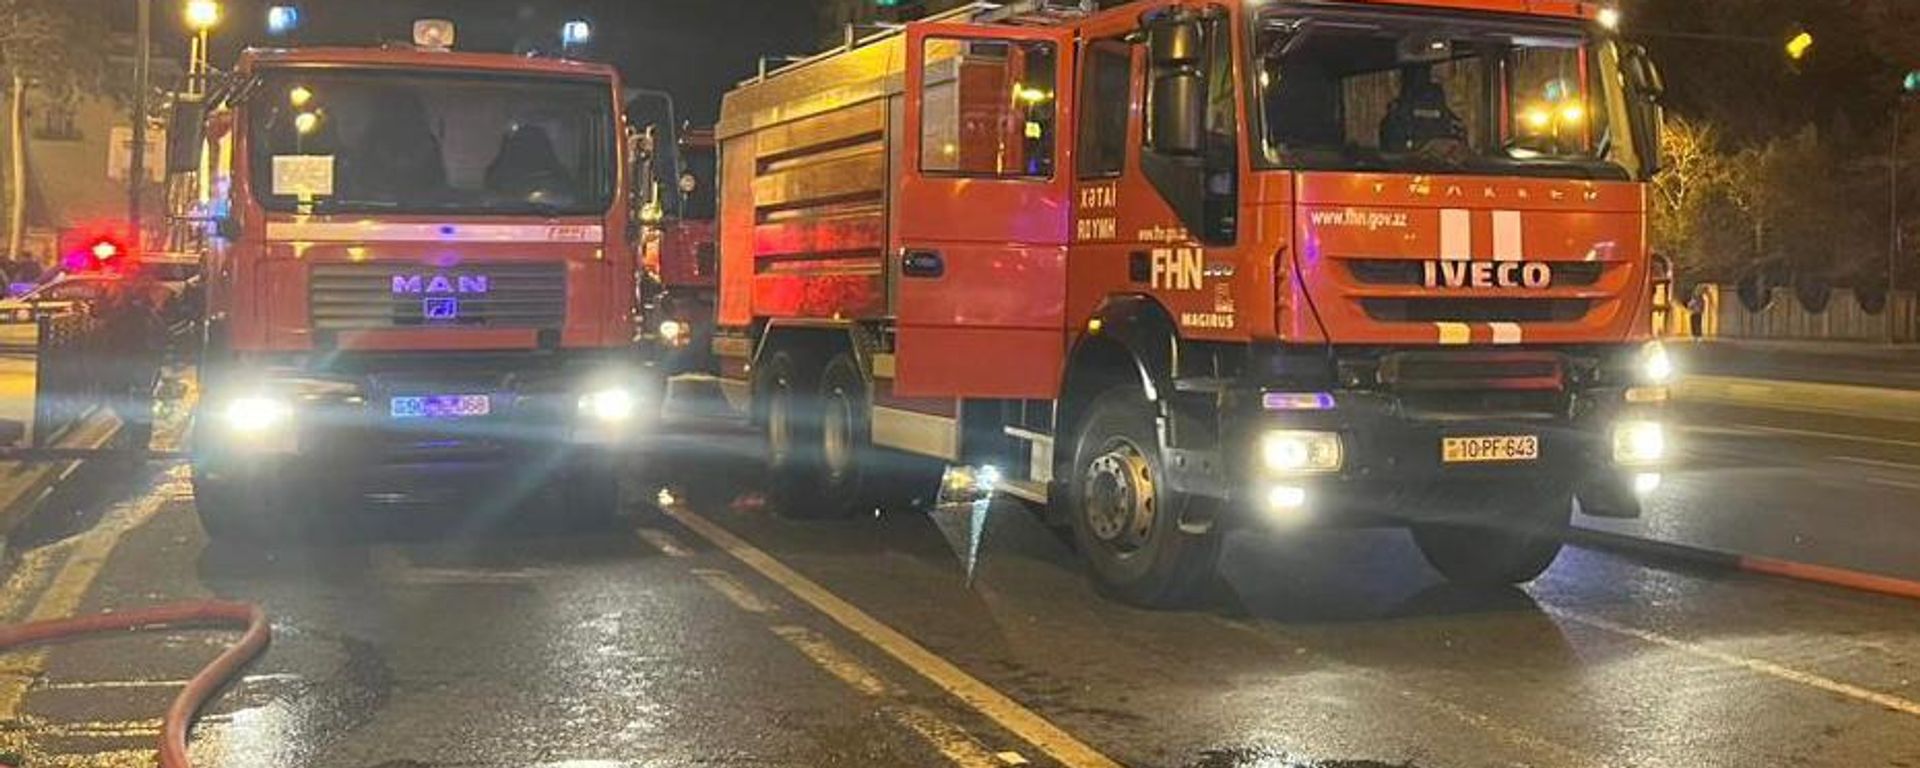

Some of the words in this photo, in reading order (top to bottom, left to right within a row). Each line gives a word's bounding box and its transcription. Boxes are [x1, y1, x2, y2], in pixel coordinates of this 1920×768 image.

[1152, 248, 1203, 290] FHN
[1423, 261, 1550, 289] IVECO
[392, 275, 487, 293] MAN
[1181, 312, 1235, 329] MAGIRUS
